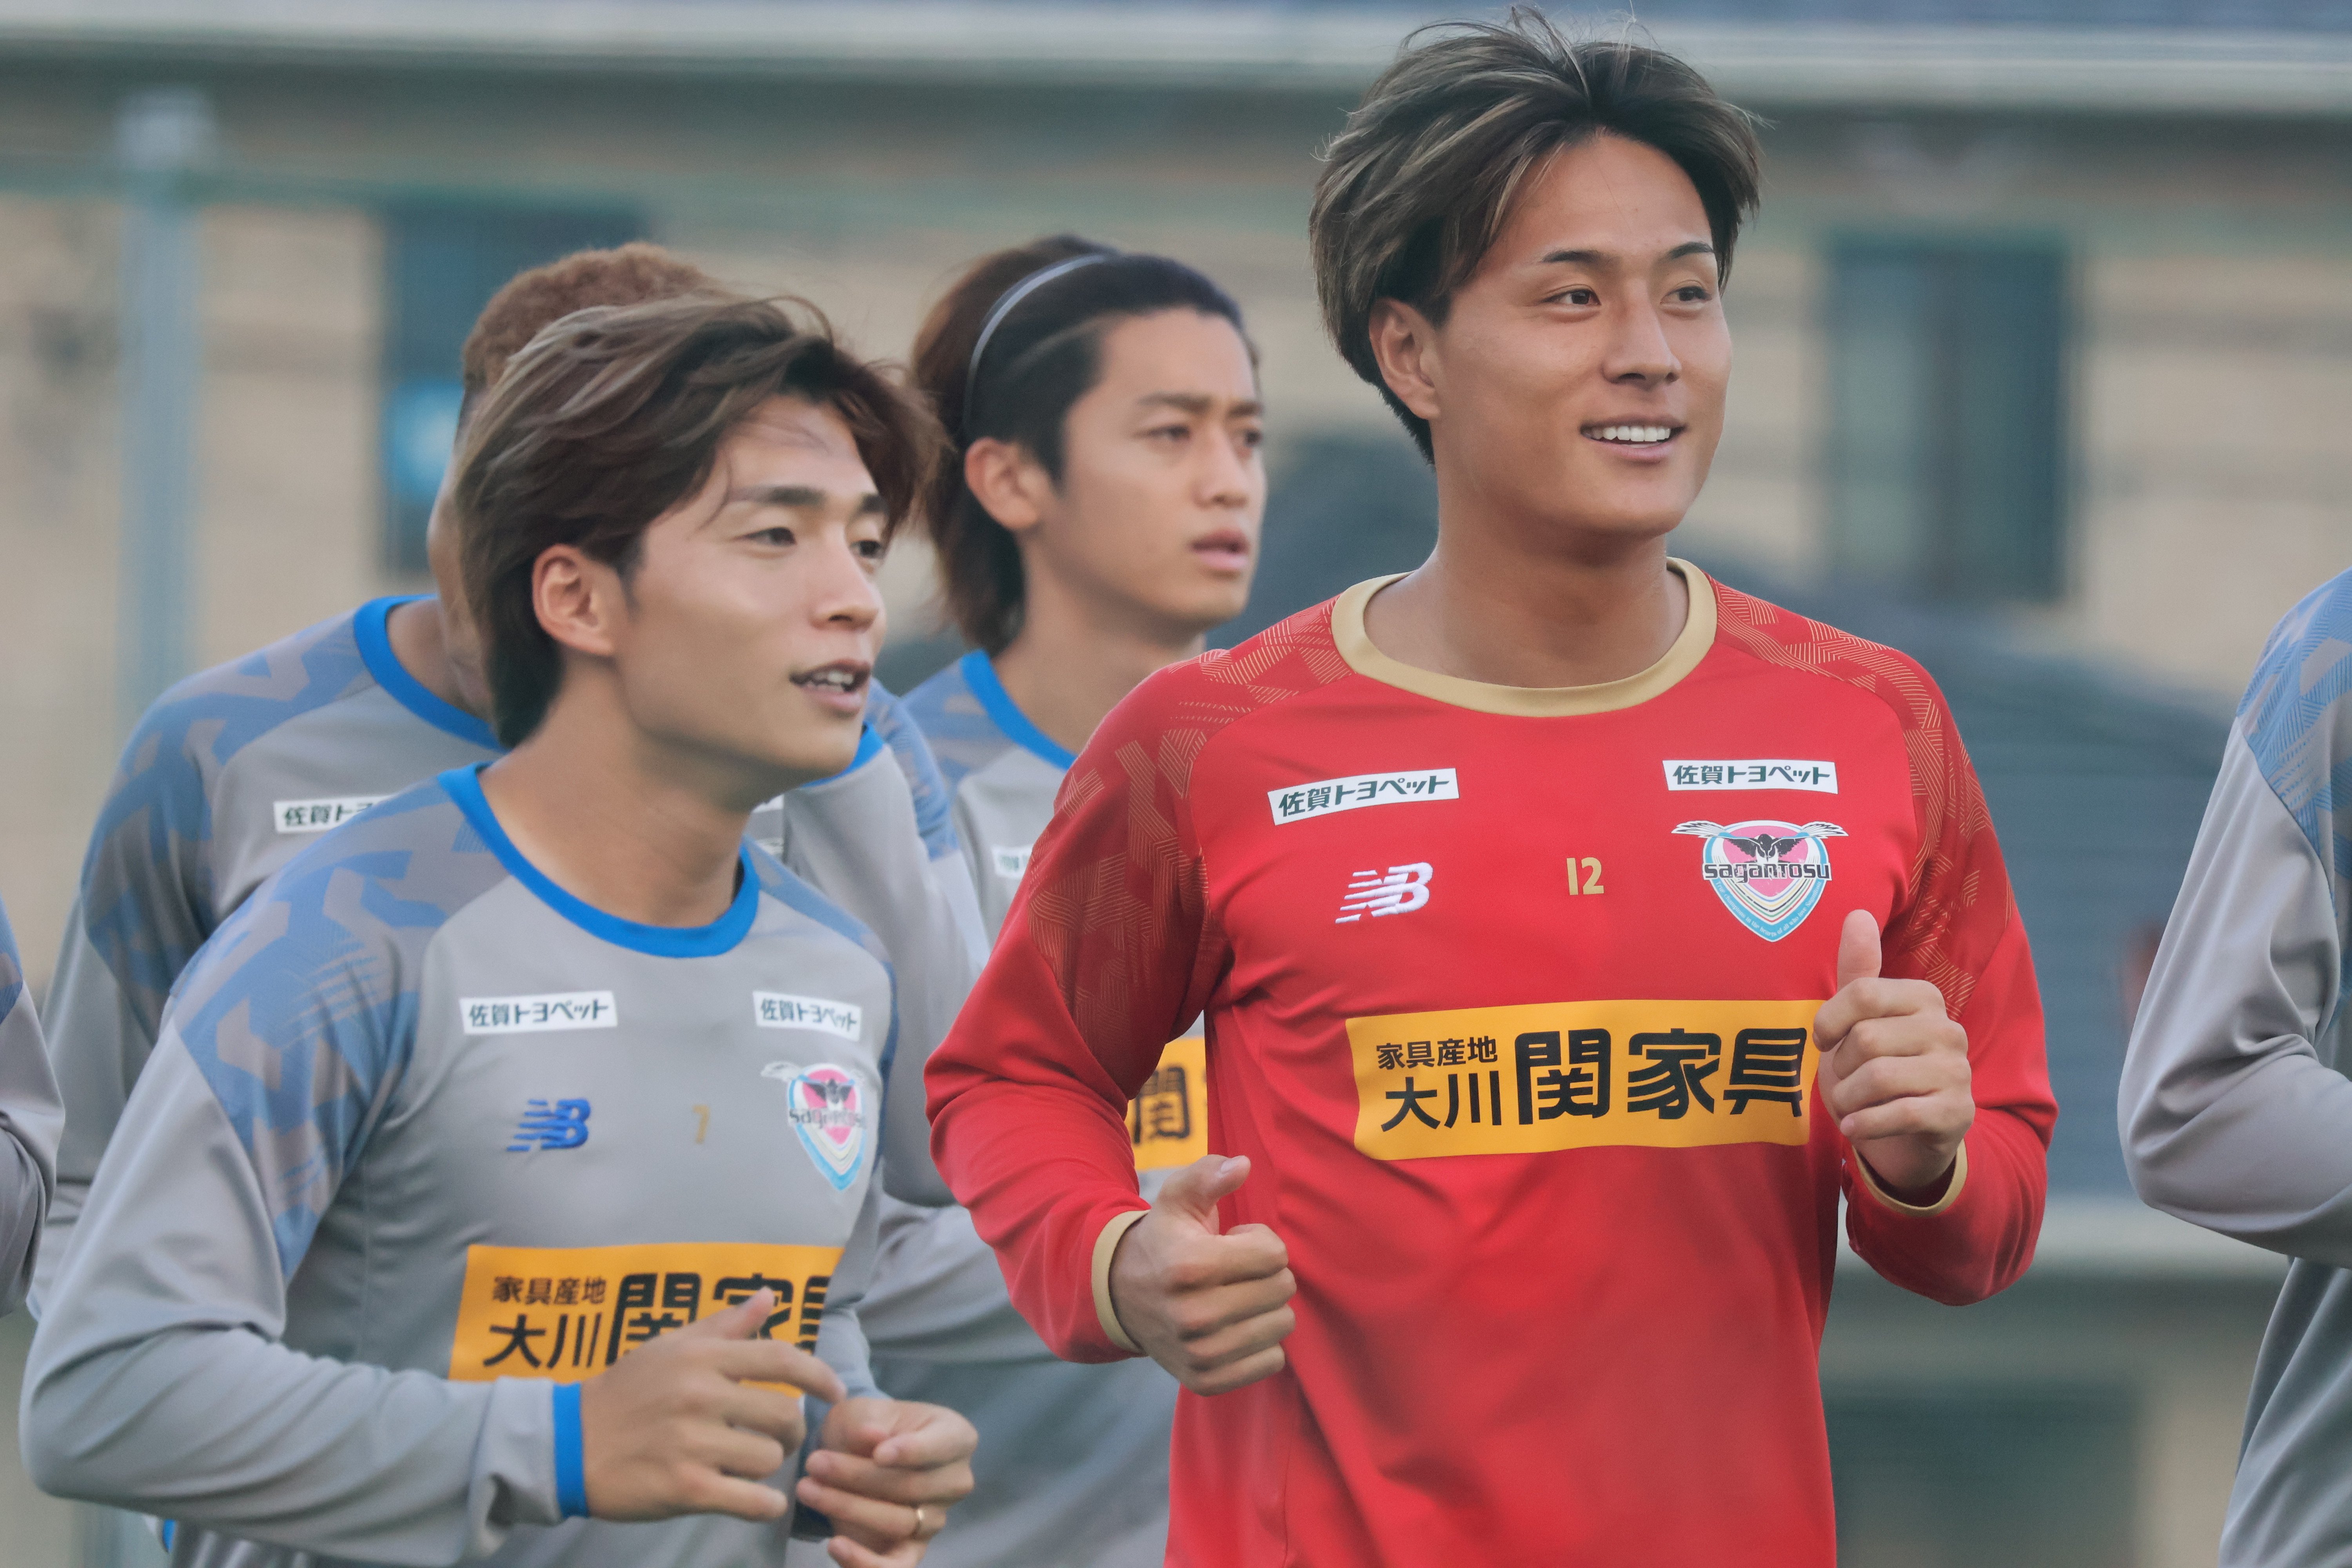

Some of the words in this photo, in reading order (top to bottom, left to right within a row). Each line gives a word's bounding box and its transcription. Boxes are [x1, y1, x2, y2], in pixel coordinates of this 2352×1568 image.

[1673, 766, 1830, 784] 佐賀トヨペット
[1279, 776, 1449, 817] 佐賀トヨペット
[1567, 857, 1604, 895] 12
[469, 999, 608, 1027] 佐賀トヨペット
[761, 999, 857, 1031] 佐賀トヨペット
[1376, 1036, 1498, 1070] 家具産地
[1514, 1028, 1808, 1125] 関家具
[1381, 1070, 1501, 1132] 大川
[692, 1105, 710, 1144] 7
[492, 1276, 606, 1305] 家具産地
[483, 1312, 603, 1369] 大川
